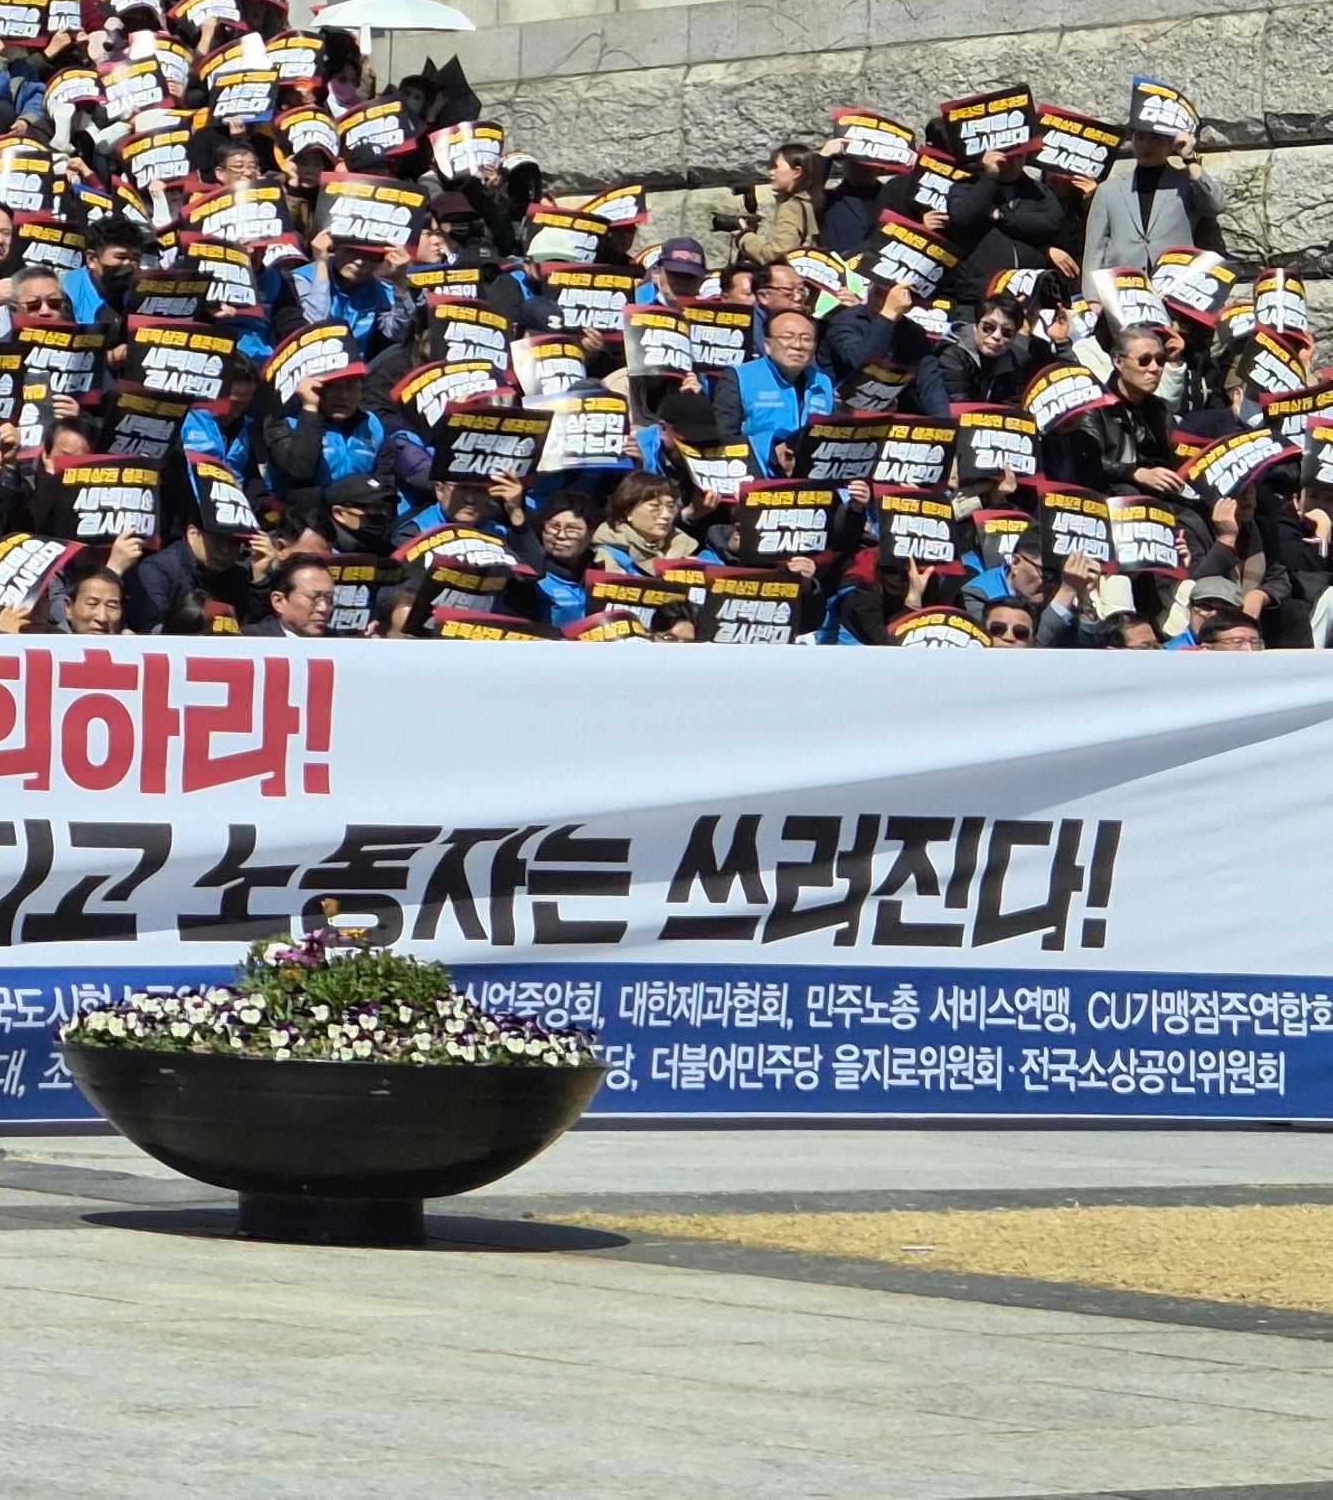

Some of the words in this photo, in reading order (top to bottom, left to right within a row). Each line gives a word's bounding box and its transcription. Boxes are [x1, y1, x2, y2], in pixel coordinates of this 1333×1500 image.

[141, 347, 223, 376] 새벽배송
[143, 369, 223, 399] 결사반대
[73, 487, 153, 512] 새벽배송
[76, 511, 156, 537] 결사반대
[177, 822, 633, 947] 노동자는
[657, 813, 1122, 951] 쓰러진다!
[618, 981, 793, 1030] 대한제과협회,
[807, 982, 920, 1030] 민주노총
[928, 984, 1076, 1035] 서비스연맹,
[651, 1043, 823, 1091] 더불어민주당
